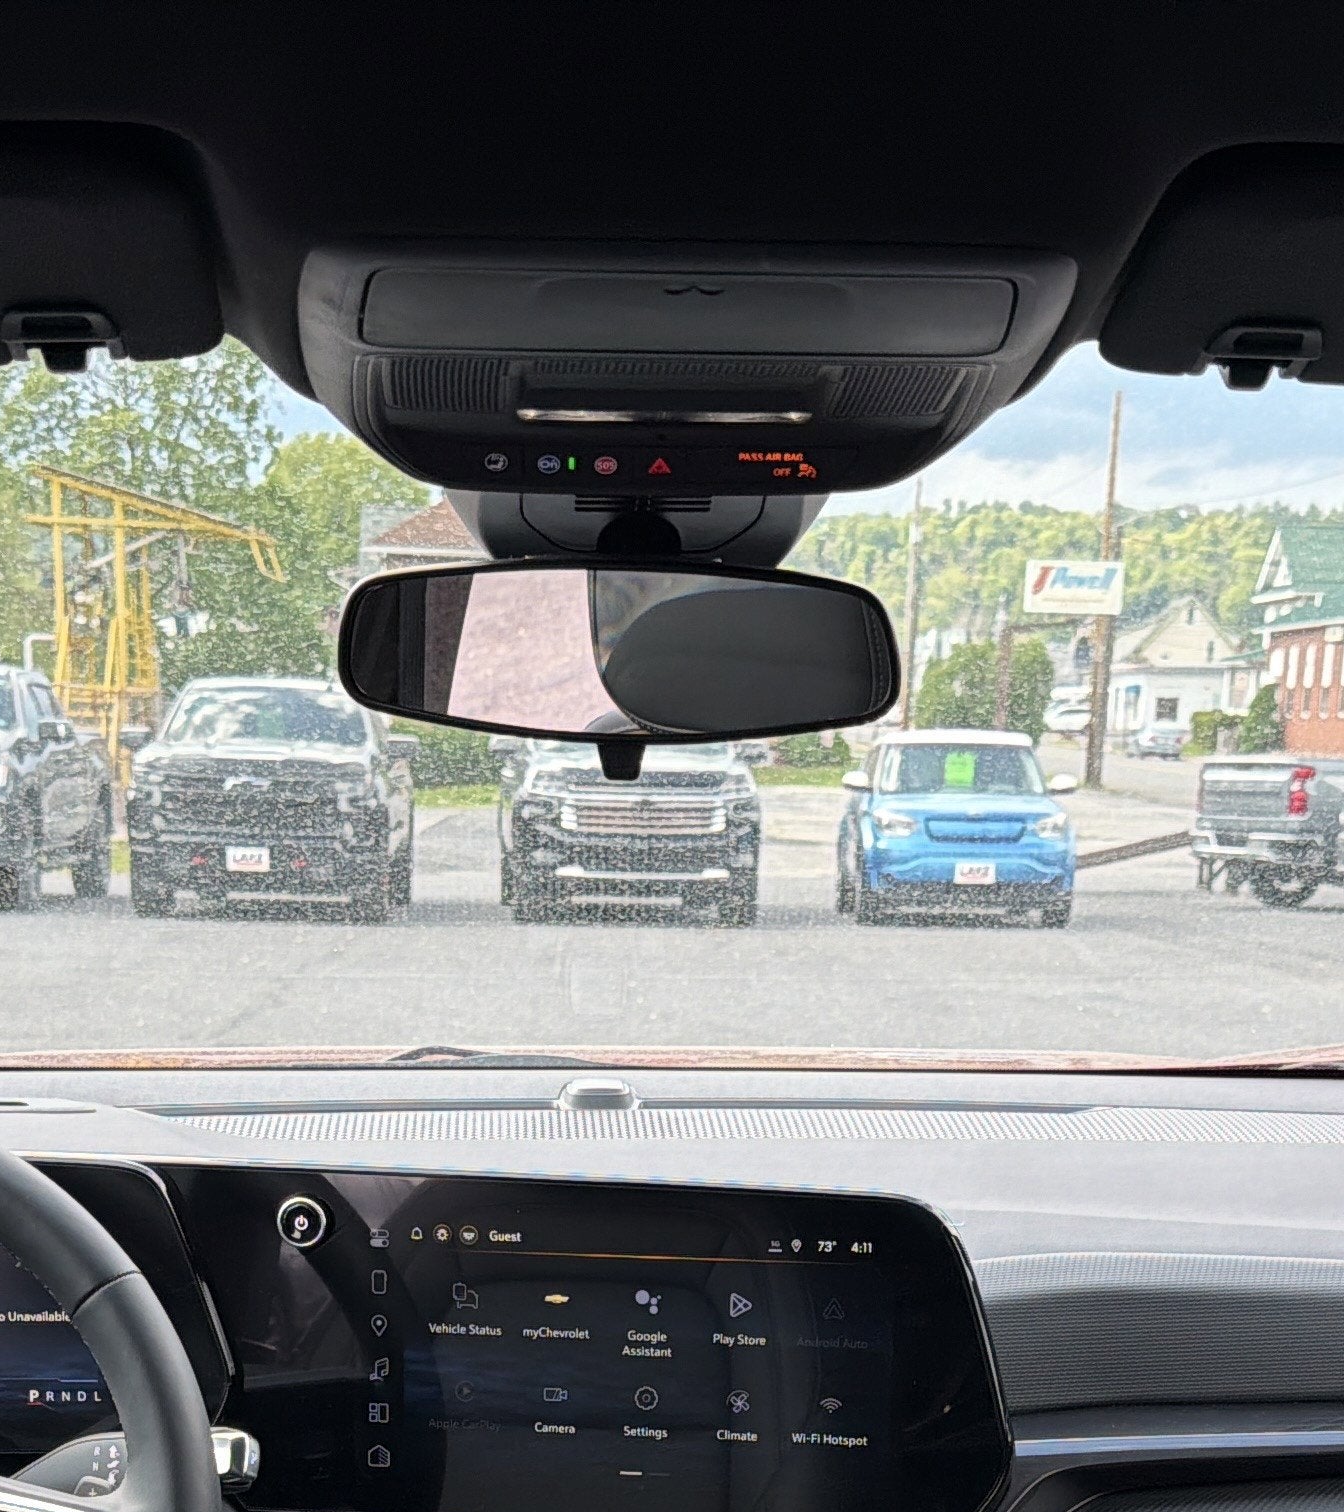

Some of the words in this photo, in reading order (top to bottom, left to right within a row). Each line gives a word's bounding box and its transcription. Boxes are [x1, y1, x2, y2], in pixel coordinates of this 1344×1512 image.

[738, 452, 764, 461] PASS
[765, 452, 782, 461] AIR
[784, 453, 804, 461] BAG
[597, 462, 615, 470] SOS
[773, 468, 792, 477] OFF
[489, 1230, 522, 1243] Guest
[817, 1241, 838, 1253] 73°
[850, 1241, 873, 1254] 4:11
[428, 1323, 467, 1335] Vehicle
[468, 1324, 503, 1336] Status
[523, 1327, 590, 1340] myChevrolet
[627, 1329, 668, 1344] Google
[712, 1333, 735, 1347] Play
[737, 1334, 767, 1346] Store
[797, 1336, 841, 1348] Android
[843, 1339, 868, 1349] Auto
[622, 1346, 672, 1358] Assistant
[29, 1389, 40, 1403] P
[45, 1391, 55, 1402] R
[61, 1391, 71, 1402] N
[77, 1391, 87, 1401] D
[94, 1391, 102, 1402] L
[428, 1418, 460, 1430] Apple
[534, 1422, 576, 1435] Camera
[623, 1425, 669, 1439] Settings
[716, 1429, 758, 1442] Climate
[792, 1433, 821, 1444] Wi-Fi
[823, 1434, 868, 1449] Hotspot
[94, 1446, 101, 1456] R
